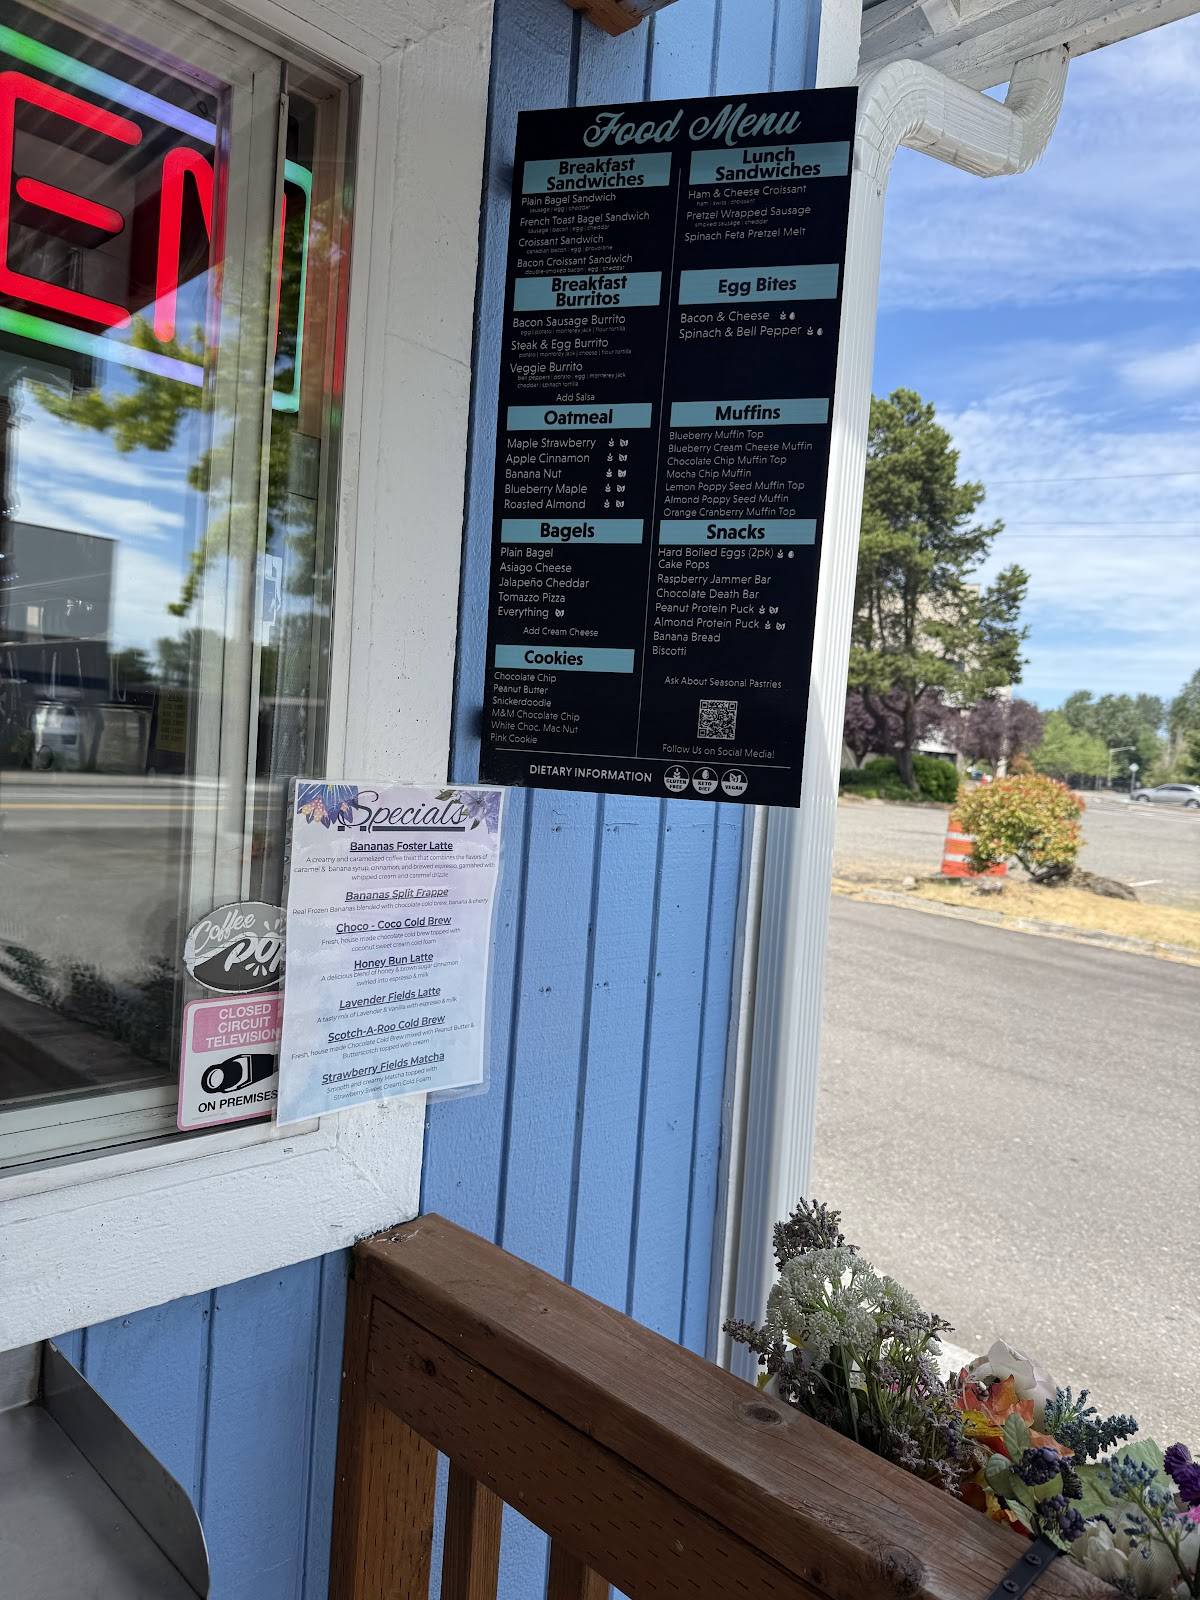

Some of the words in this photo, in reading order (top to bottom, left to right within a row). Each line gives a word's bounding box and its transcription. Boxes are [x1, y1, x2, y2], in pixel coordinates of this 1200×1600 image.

[583, 109, 684, 147] Food
[688, 103, 801, 146] Menu
[743, 147, 795, 164] Lunch
[559, 158, 635, 174] Breakfast
[716, 162, 821, 181] Sandwiches
[547, 173, 644, 191] Sandwiches
[522, 197, 542, 206] Plain
[545, 196, 570, 206] Bagel
[572, 192, 616, 203] Sandwich
[688, 190, 710, 199] Ham
[713, 189, 720, 198] &
[724, 188, 760, 197] Cheese
[763, 185, 807, 195] Croissant
[520, 217, 550, 226] French
[552, 216, 575, 224] Toast
[578, 215, 603, 225] Bagel
[605, 211, 649, 222] Sandwich
[687, 210, 718, 220] Pretzel
[721, 208, 767, 221] Wrapped
[770, 206, 811, 216] Sausage
[518, 238, 558, 247] Croissant
[560, 235, 604, 244] Sandwich
[684, 231, 721, 243] Spinach
[725, 231, 745, 239] Feta
[748, 229, 780, 238] Pretzel
[783, 227, 805, 237] Melt
[552, 276, 627, 292] Breakfast
[718, 280, 751, 296] Egg
[756, 277, 796, 291] Bites
[556, 291, 620, 307] Burritos
[513, 318, 543, 328] Bacon
[546, 317, 588, 327] Sausage
[592, 315, 625, 324] Burrito
[680, 313, 713, 323] Bacon
[717, 312, 724, 321] &
[729, 311, 770, 321] Cheese
[680, 328, 721, 341] Spinach
[725, 327, 733, 336] &
[737, 326, 756, 336] Bell
[760, 325, 802, 338] Pepper
[512, 340, 537, 350] Steak
[540, 340, 548, 349] &
[551, 340, 571, 351] Egg
[575, 338, 608, 348] Burrito
[510, 363, 546, 375] Veggie
[550, 362, 582, 371] Burrito
[576, 393, 595, 401] Salsa
[544, 409, 613, 425] Oatmeal
[716, 405, 780, 420] Muffins
[670, 432, 712, 441] Blueberry
[715, 430, 744, 439] Muffin
[747, 430, 764, 439] Top
[507, 439, 538, 450] Maple
[541, 437, 596, 449] Strawberry
[506, 454, 536, 465] Apple
[539, 453, 590, 463] Cinnamon
[506, 469, 540, 478] Banana
[544, 469, 562, 478] Nut
[667, 470, 696, 478] Mocha
[699, 469, 719, 479] Chip
[722, 469, 751, 478] Muffin
[505, 484, 553, 495] Blueberry
[556, 484, 587, 495] Maple
[504, 499, 543, 509] Roasted
[546, 499, 585, 509] Almond
[664, 508, 697, 518] Orange
[700, 508, 744, 518] Cranberry
[746, 507, 776, 516] Muffin
[779, 507, 796, 516] Top
[540, 522, 595, 542] Bagels
[707, 524, 765, 540] Snacks
[501, 547, 522, 557] Plain
[526, 548, 553, 559] Bagel
[658, 548, 682, 557] Hard
[685, 548, 717, 557] Boiled
[720, 548, 746, 559] Eggs
[748, 548, 774, 559] (2pk)
[499, 562, 532, 574] Asiago
[535, 563, 572, 572] Cheese
[658, 560, 682, 568] Cake
[685, 560, 710, 571] Pops
[499, 578, 543, 588] Jalapeño
[546, 578, 589, 588] Cheddar
[499, 592, 539, 602] Tomazzo
[543, 593, 566, 603] Pizza
[656, 588, 706, 598] Chocolate
[709, 589, 739, 598] Death
[743, 590, 759, 598] Bar
[498, 607, 549, 619] Everything
[655, 603, 689, 612] Peanut
[692, 604, 727, 613] Protein
[731, 604, 754, 614] Puck
[654, 632, 688, 641] Banana
[691, 633, 720, 642] Bread
[652, 646, 687, 655] Biscotti
[524, 650, 584, 666] Cookies
[494, 672, 535, 681] Chocolate
[537, 674, 557, 684] Chip
[664, 676, 679, 684] Ask
[681, 677, 708, 686] About
[710, 678, 747, 687] Seasonal
[750, 679, 782, 689] Pastries
[492, 696, 552, 707] Snickerdoodle
[663, 744, 690, 753] Follow
[692, 746, 702, 754] Us
[718, 747, 742, 757] Social
[745, 749, 775, 759] Media!
[530, 765, 573, 776] DIETARY
[575, 768, 652, 782] INFORMATION
[338, 790, 468, 834] Specials
[350, 842, 394, 851] Bananas
[429, 842, 453, 850] Latte
[345, 890, 390, 901] Bananas
[393, 889, 414, 900] Split
[416, 888, 449, 899] Frappe
[195, 909, 256, 951] Coffee
[336, 922, 369, 933] Choco
[377, 920, 401, 930] Coco
[404, 918, 425, 927] Cold
[427, 917, 451, 926] Brew
[354, 959, 386, 970] Honey
[389, 955, 408, 965] Bun
[410, 953, 434, 962] Latte
[339, 995, 386, 1009] Lavender
[388, 991, 416, 1002] Fields
[418, 987, 441, 998] Latte
[219, 1004, 271, 1019] CLOSED
[218, 1017, 271, 1033] CIRCUIT
[328, 1023, 396, 1042] Scotch-A-Roo
[398, 1019, 420, 1030] Cold
[422, 1014, 445, 1026] Brew
[206, 1028, 279, 1048] TELEVISION
[322, 1065, 378, 1084] Strawberry
[380, 1059, 408, 1071] Fields
[411, 1052, 445, 1065] Matcha
[198, 1101, 216, 1112] ON
[220, 1090, 278, 1109] PREMISES
